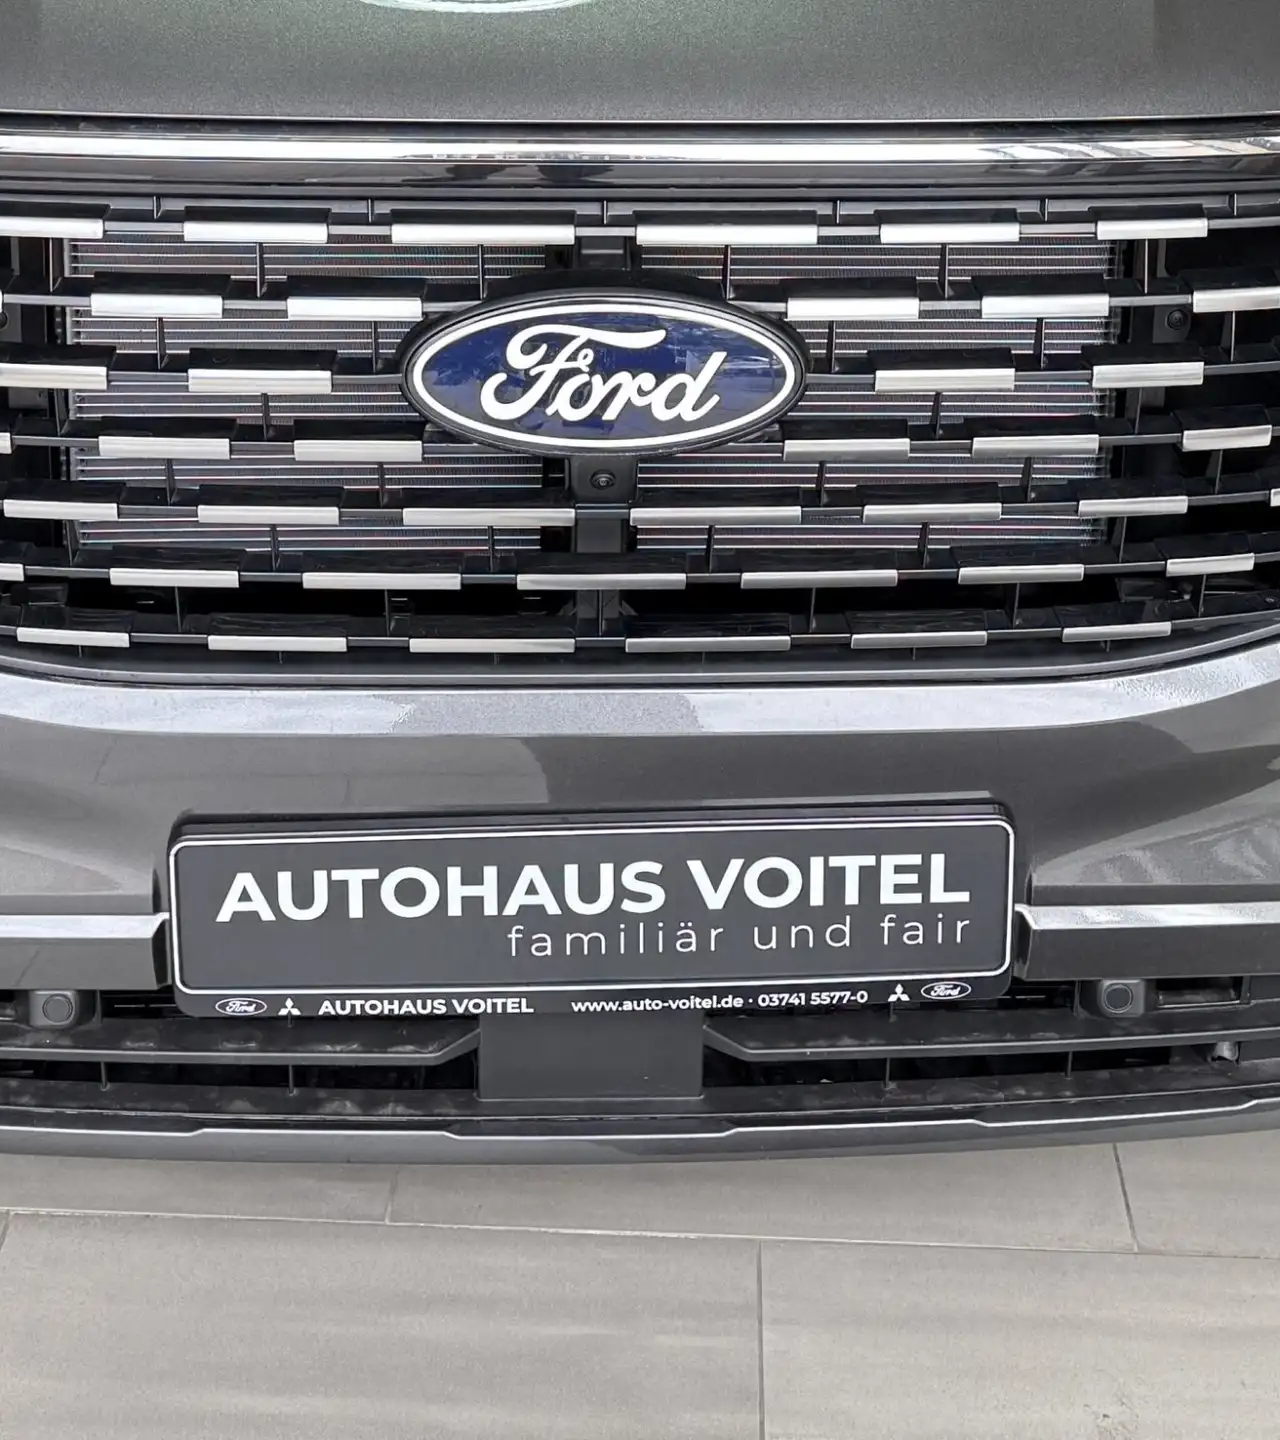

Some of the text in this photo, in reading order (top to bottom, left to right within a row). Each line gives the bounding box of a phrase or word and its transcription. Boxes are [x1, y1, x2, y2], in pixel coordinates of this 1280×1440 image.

[480, 323, 728, 423] Ford
[215, 853, 970, 922] AUTOHAUS VOITEL
[507, 913, 970, 957] familiär und fair
[571, 990, 869, 1012] www.auto-voitel.de 03741 5577-0
[930, 984, 961, 997] Ford
[225, 1000, 257, 1013] Ford
[317, 997, 535, 1016] AUTOHAUS VOITEL
